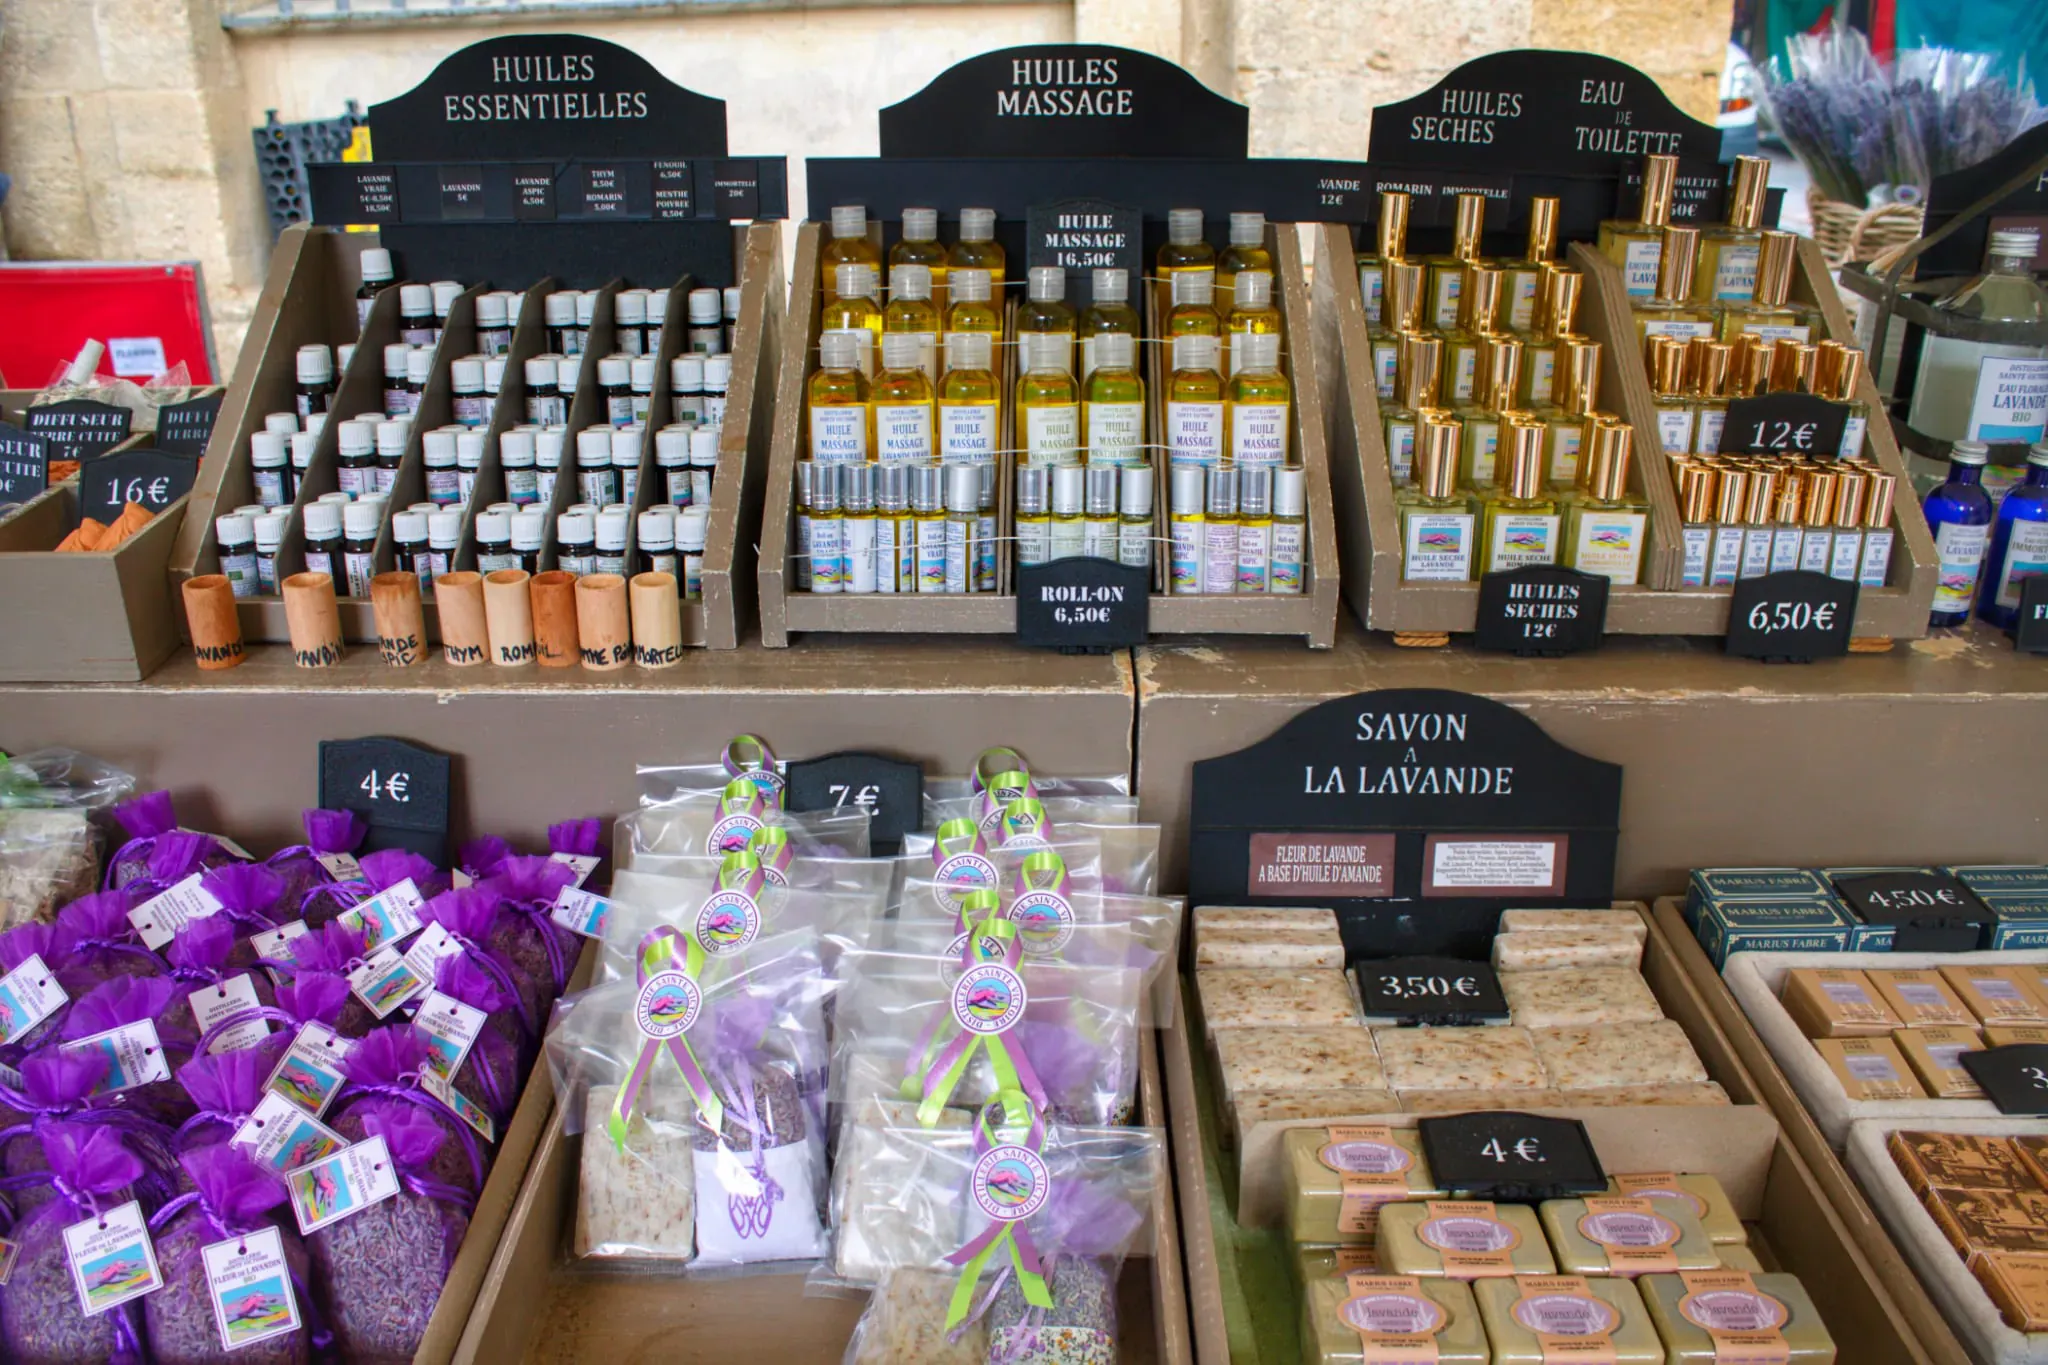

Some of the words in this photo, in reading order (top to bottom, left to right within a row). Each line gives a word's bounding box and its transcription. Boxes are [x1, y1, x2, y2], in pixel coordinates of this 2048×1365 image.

[492, 55, 595, 82] HUILES
[1012, 58, 1119, 85] HUILES
[1580, 80, 1625, 105] EAU
[445, 92, 648, 121] ESSENTIELLES
[997, 89, 1133, 116] MASSAGE
[1441, 89, 1523, 117] HUILES
[1615, 111, 1632, 126] DE
[1410, 117, 1494, 144] SECHES
[1575, 126, 1682, 155] TOILETTE
[654, 161, 688, 169] FENOUIL
[591, 170, 615, 178] THYM
[515, 178, 551, 186] LAVANDE
[714, 180, 756, 188] IMMORTELLE
[1319, 179, 1360, 191] VANDE
[1674, 177, 1720, 188] OILETTE
[364, 185, 388, 193] VRAIE
[442, 184, 481, 192] LAVANDIN
[457, 194, 468, 202] 5€
[585, 193, 623, 201] ROMARIN
[655, 190, 689, 199] MENTHE
[1321, 194, 1343, 205] 12€
[655, 200, 690, 208] POIVREE
[1059, 214, 1113, 229] HUILE
[1045, 232, 1126, 249] MASSAGE
[1056, 250, 1115, 268] 16,50€
[1632, 272, 1656, 283] LAVA
[1723, 276, 1754, 287] LAVAN
[1998, 384, 2017, 393] EAU
[31, 413, 124, 427] DIFFUSEUR
[2011, 412, 2032, 422] BIO
[826, 425, 851, 435] HUILE
[892, 424, 918, 434] HUILE
[955, 424, 980, 434] HUILE
[1046, 424, 1070, 436] HUILE
[1105, 422, 1130, 432] HUILE
[1182, 422, 1208, 432] HUILE
[1250, 424, 1275, 434] HUILE
[78, 431, 121, 442] CUITE
[1750, 421, 1818, 449] 12€
[821, 440, 857, 449] MASSAGE
[887, 439, 923, 448] MASSAGE
[950, 439, 986, 448] MASSAGE
[1040, 438, 1076, 448] MASSAGE
[1099, 436, 1136, 446] MASSAGE
[1176, 436, 1213, 447] MASSAGE
[1244, 438, 1280, 448] MASSAGE
[63, 446, 83, 458] 7€
[107, 476, 170, 506] 16€
[1041, 586, 1124, 602] ROLL-ON
[1509, 583, 1580, 599] HUILES
[1054, 607, 1111, 623] 6,50€
[1504, 604, 1579, 619] SECHES
[1749, 602, 1838, 634] 6,50€
[1522, 623, 1557, 638] 12€
[1357, 712, 1468, 742] SAVON
[1305, 766, 1346, 795] LA
[1358, 767, 1513, 795] LAVANDE
[361, 771, 411, 803] 4€
[829, 785, 880, 817] 7€
[1276, 846, 1307, 864] FLEUR
[1308, 846, 1322, 863] DE
[1323, 846, 1367, 864] LAVANDE
[1259, 866, 1266, 882] A
[1267, 866, 1296, 882] BASE
[1297, 866, 1333, 882] D'HUILE
[1334, 866, 1382, 883] D'AMANDE
[1725, 908, 1780, 916] MARIUS
[1784, 907, 1826, 915] FABRE
[1745, 939, 1789, 949] MARIUS
[1792, 938, 1828, 948] FABRE
